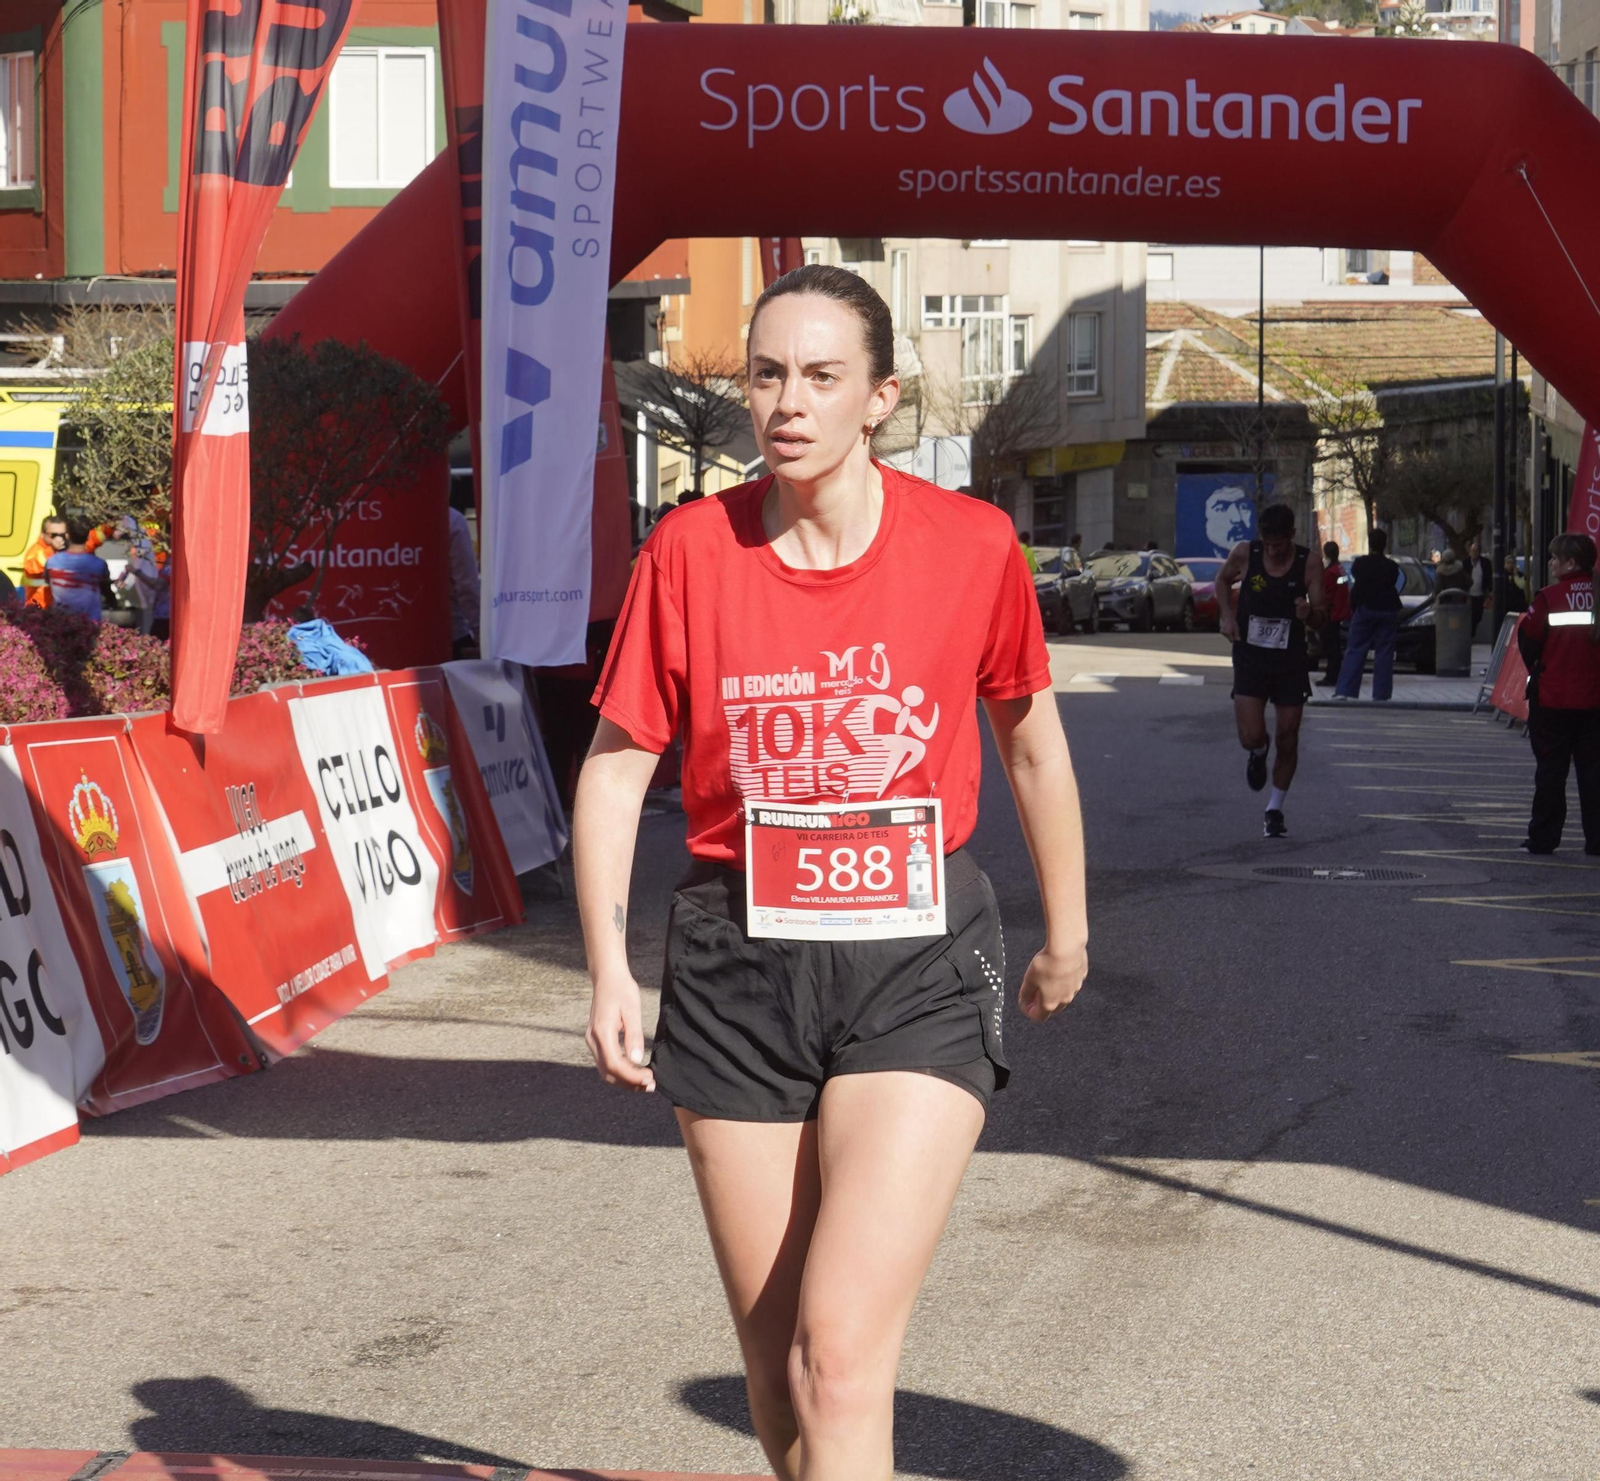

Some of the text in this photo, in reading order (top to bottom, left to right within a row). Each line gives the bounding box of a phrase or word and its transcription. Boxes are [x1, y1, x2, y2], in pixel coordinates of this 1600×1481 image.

[700, 67, 1422, 149] Sports Santander
[572, 0, 615, 257] SPORTWE
[898, 165, 1221, 198] sportssantander.es
[284, 542, 422, 569] Santander
[1258, 626, 1280, 638] 307
[722, 666, 815, 700] III EDICIÓN
[734, 698, 867, 764] 10K
[318, 745, 400, 822] CELLO
[752, 763, 850, 797] TEIS
[797, 830, 889, 841] VII CARREIRA DE TEIS
[908, 825, 928, 839] 5K
[351, 829, 421, 904] VIGO
[796, 845, 893, 892] 588
[810, 896, 855, 904] VILLANUEVA
[855, 894, 899, 903] FERNANDEZ
